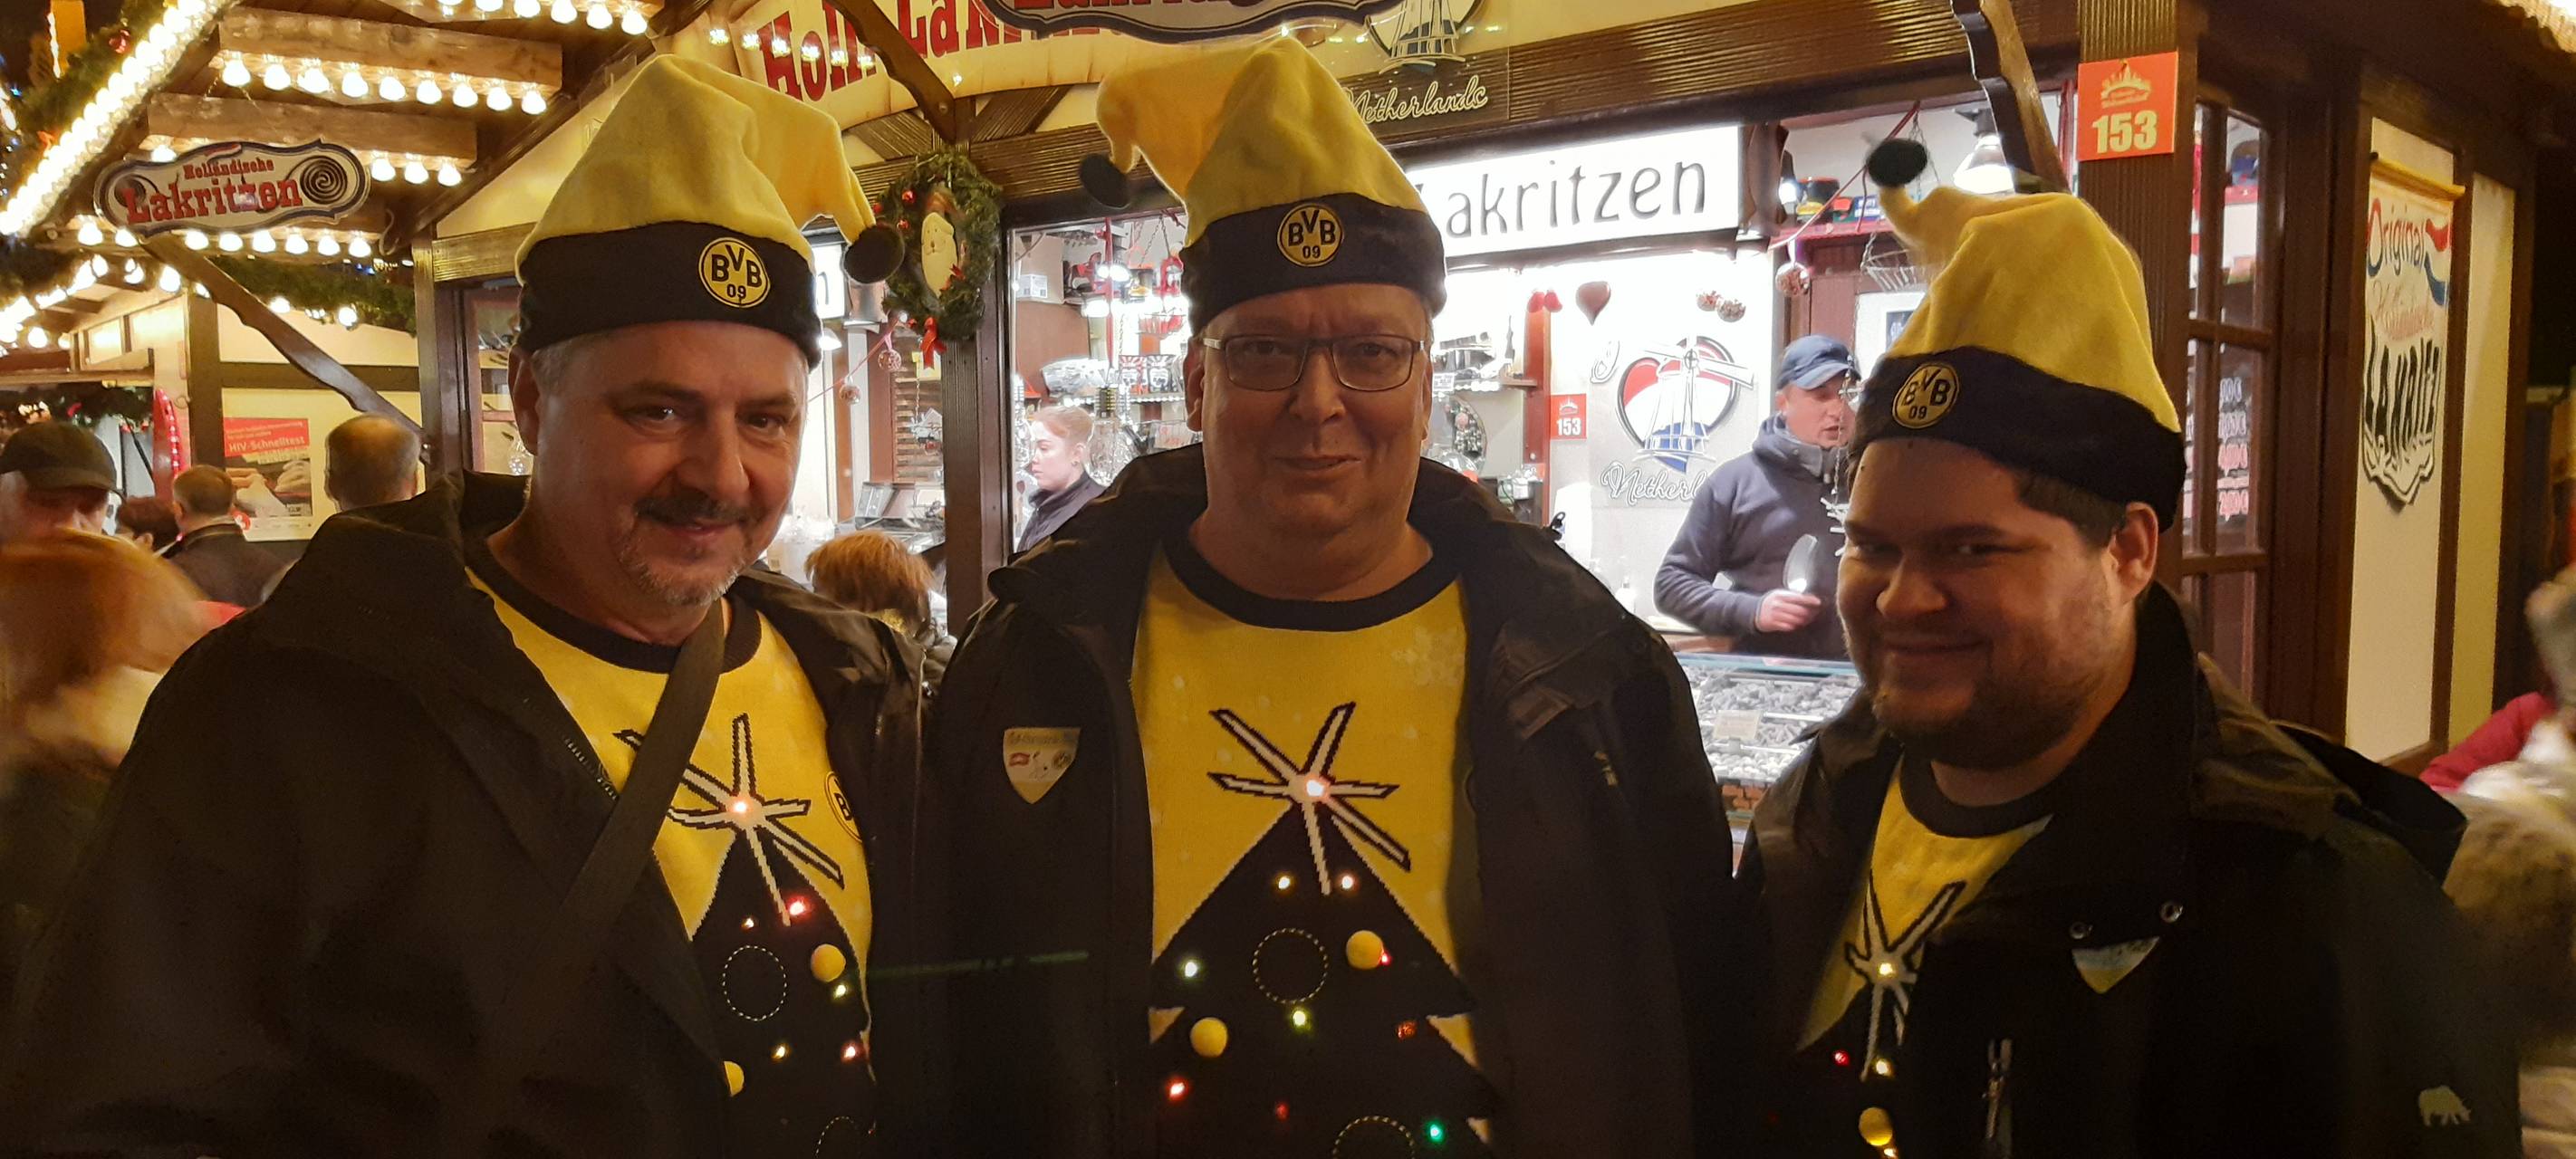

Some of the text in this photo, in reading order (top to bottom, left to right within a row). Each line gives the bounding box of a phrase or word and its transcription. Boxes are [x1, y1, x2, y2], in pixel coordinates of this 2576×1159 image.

[2092, 110, 2158, 154] 153
[121, 179, 303, 225] Lakritzen
[1415, 161, 1706, 238] akritzen
[1288, 209, 1336, 246] BVB
[2365, 197, 2425, 276] Original
[711, 244, 763, 287] BVB
[1302, 245, 1321, 259] 09
[726, 283, 747, 300] 09
[1901, 369, 1951, 406] BVB
[1556, 417, 1581, 436] 153
[1908, 406, 1927, 419] 09
[229, 436, 305, 453] HIV-Schnelltest
[1600, 461, 1707, 506] Netherl
